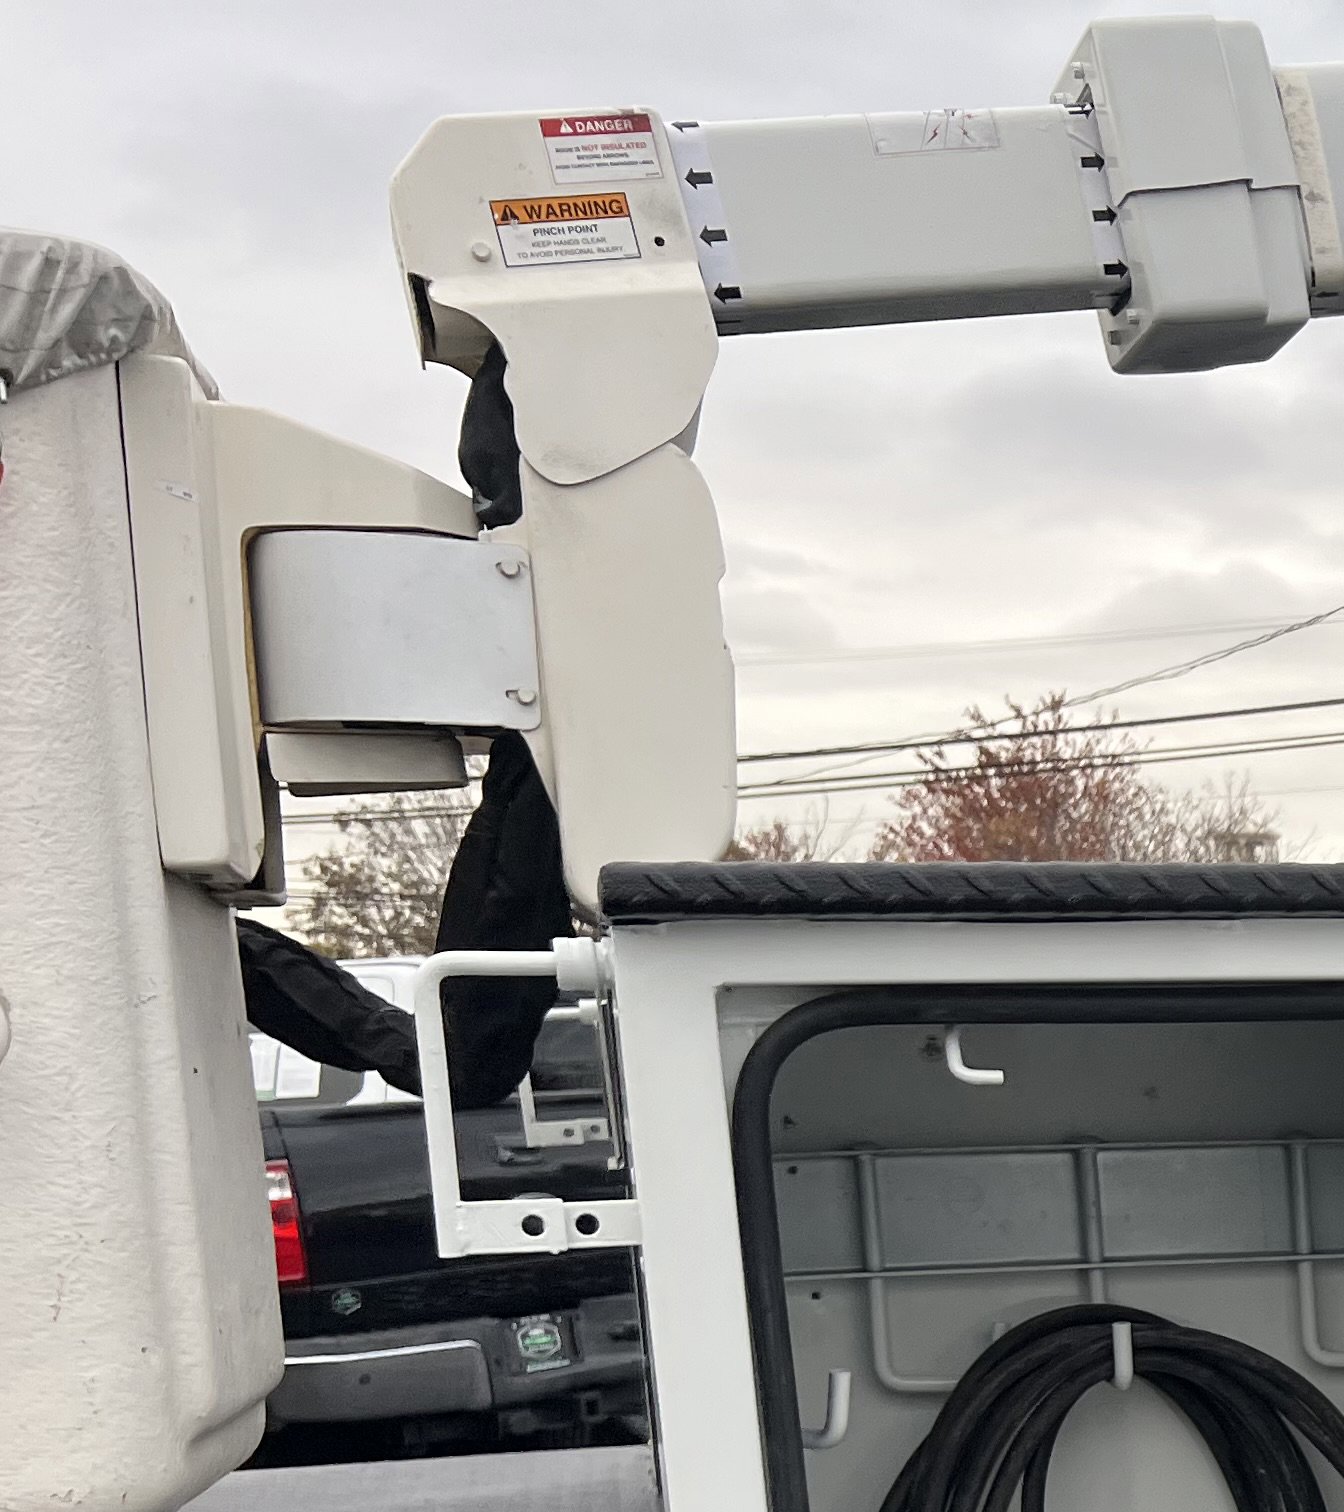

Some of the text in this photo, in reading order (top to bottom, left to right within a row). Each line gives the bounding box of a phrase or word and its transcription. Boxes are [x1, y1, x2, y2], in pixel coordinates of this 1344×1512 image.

[575, 119, 634, 133] DANGER
[523, 199, 624, 220] WARNING
[533, 224, 599, 236] PINCH POINT
[532, 236, 607, 248] KEEP HANDS CLEAR
[530, 250, 553, 258] AVOID
[555, 248, 594, 256] PERSONAL
